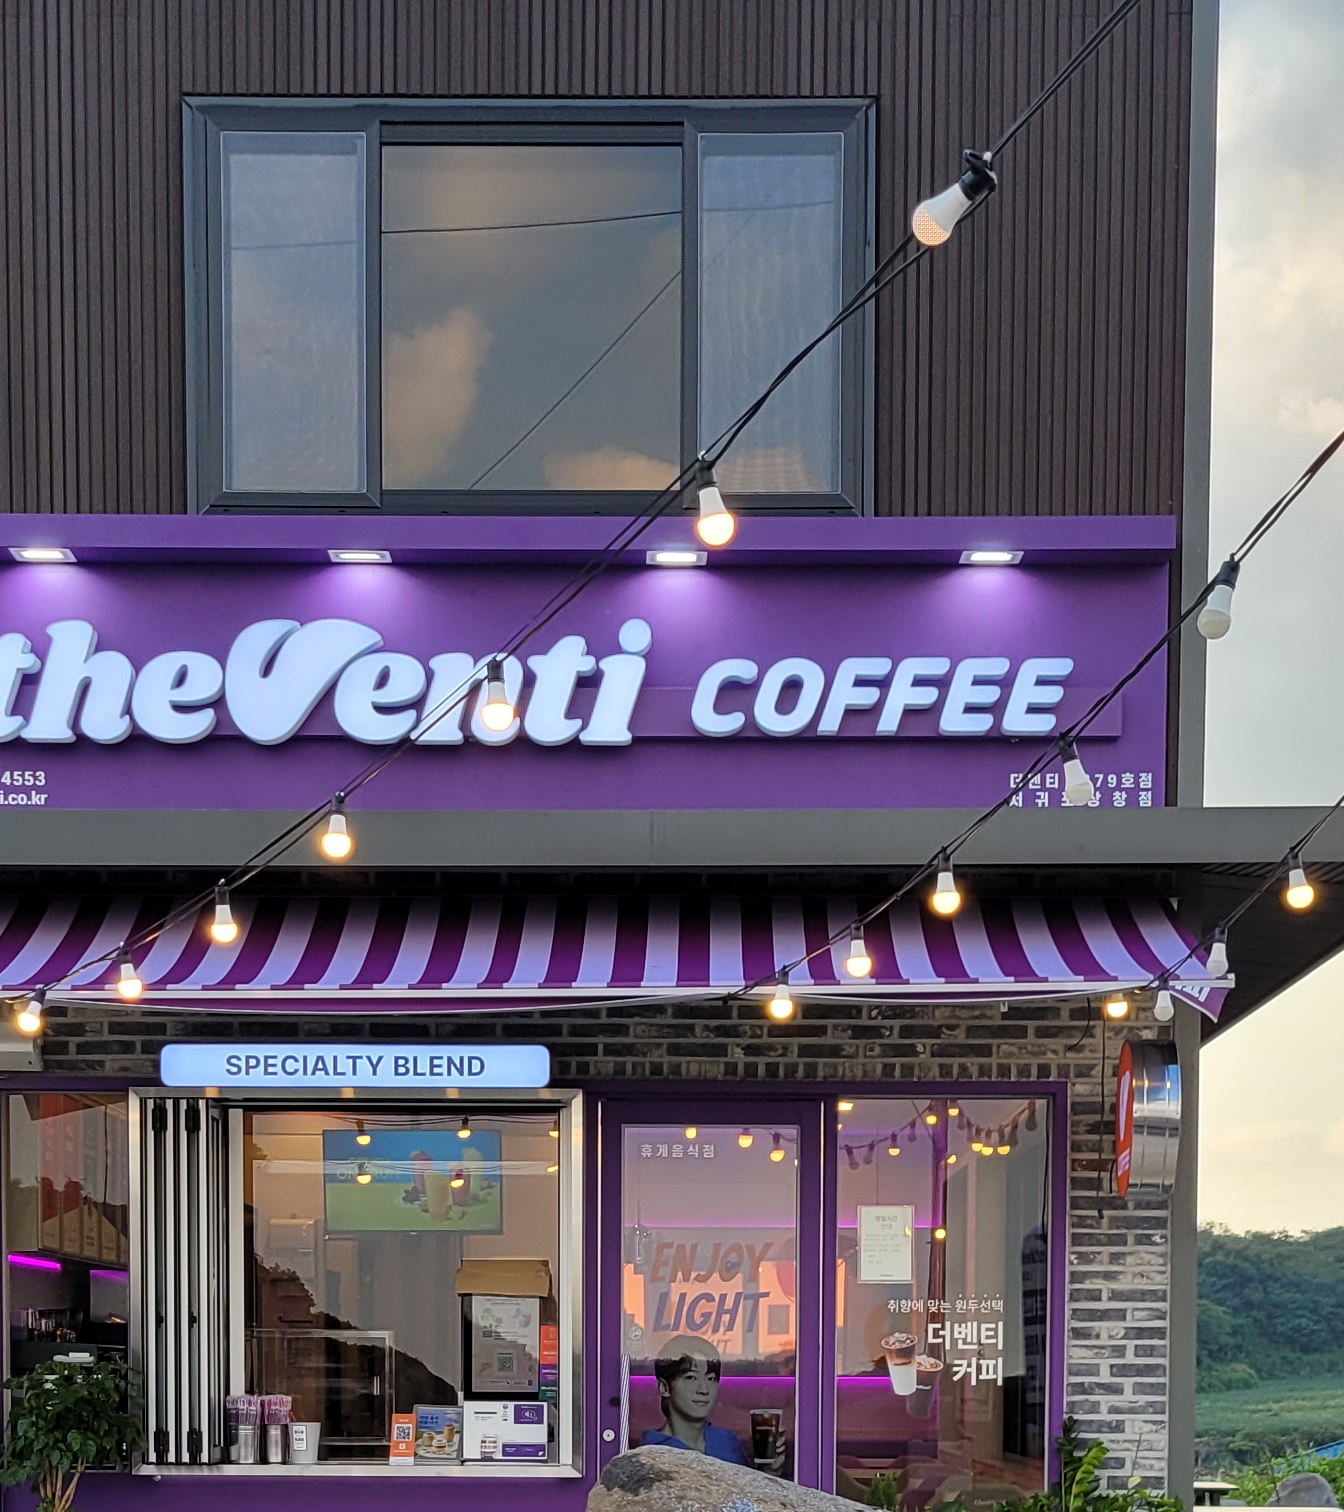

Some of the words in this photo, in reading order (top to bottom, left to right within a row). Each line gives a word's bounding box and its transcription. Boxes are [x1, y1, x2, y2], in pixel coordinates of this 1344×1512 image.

[690, 656, 1075, 737] COFFEE
[224, 1054, 385, 1077] SPECIALTY
[393, 1055, 486, 1077] BLEND
[640, 1143, 716, 1159] 휴게음식점
[649, 1241, 774, 1284] ENJOY
[652, 1290, 771, 1333] LIGHT
[887, 1298, 924, 1313] 취향에
[927, 1298, 952, 1313] 맞는
[954, 1298, 1004, 1313] 원두선택
[927, 1321, 1004, 1350] 더벤티
[952, 1357, 1003, 1386] 커피
